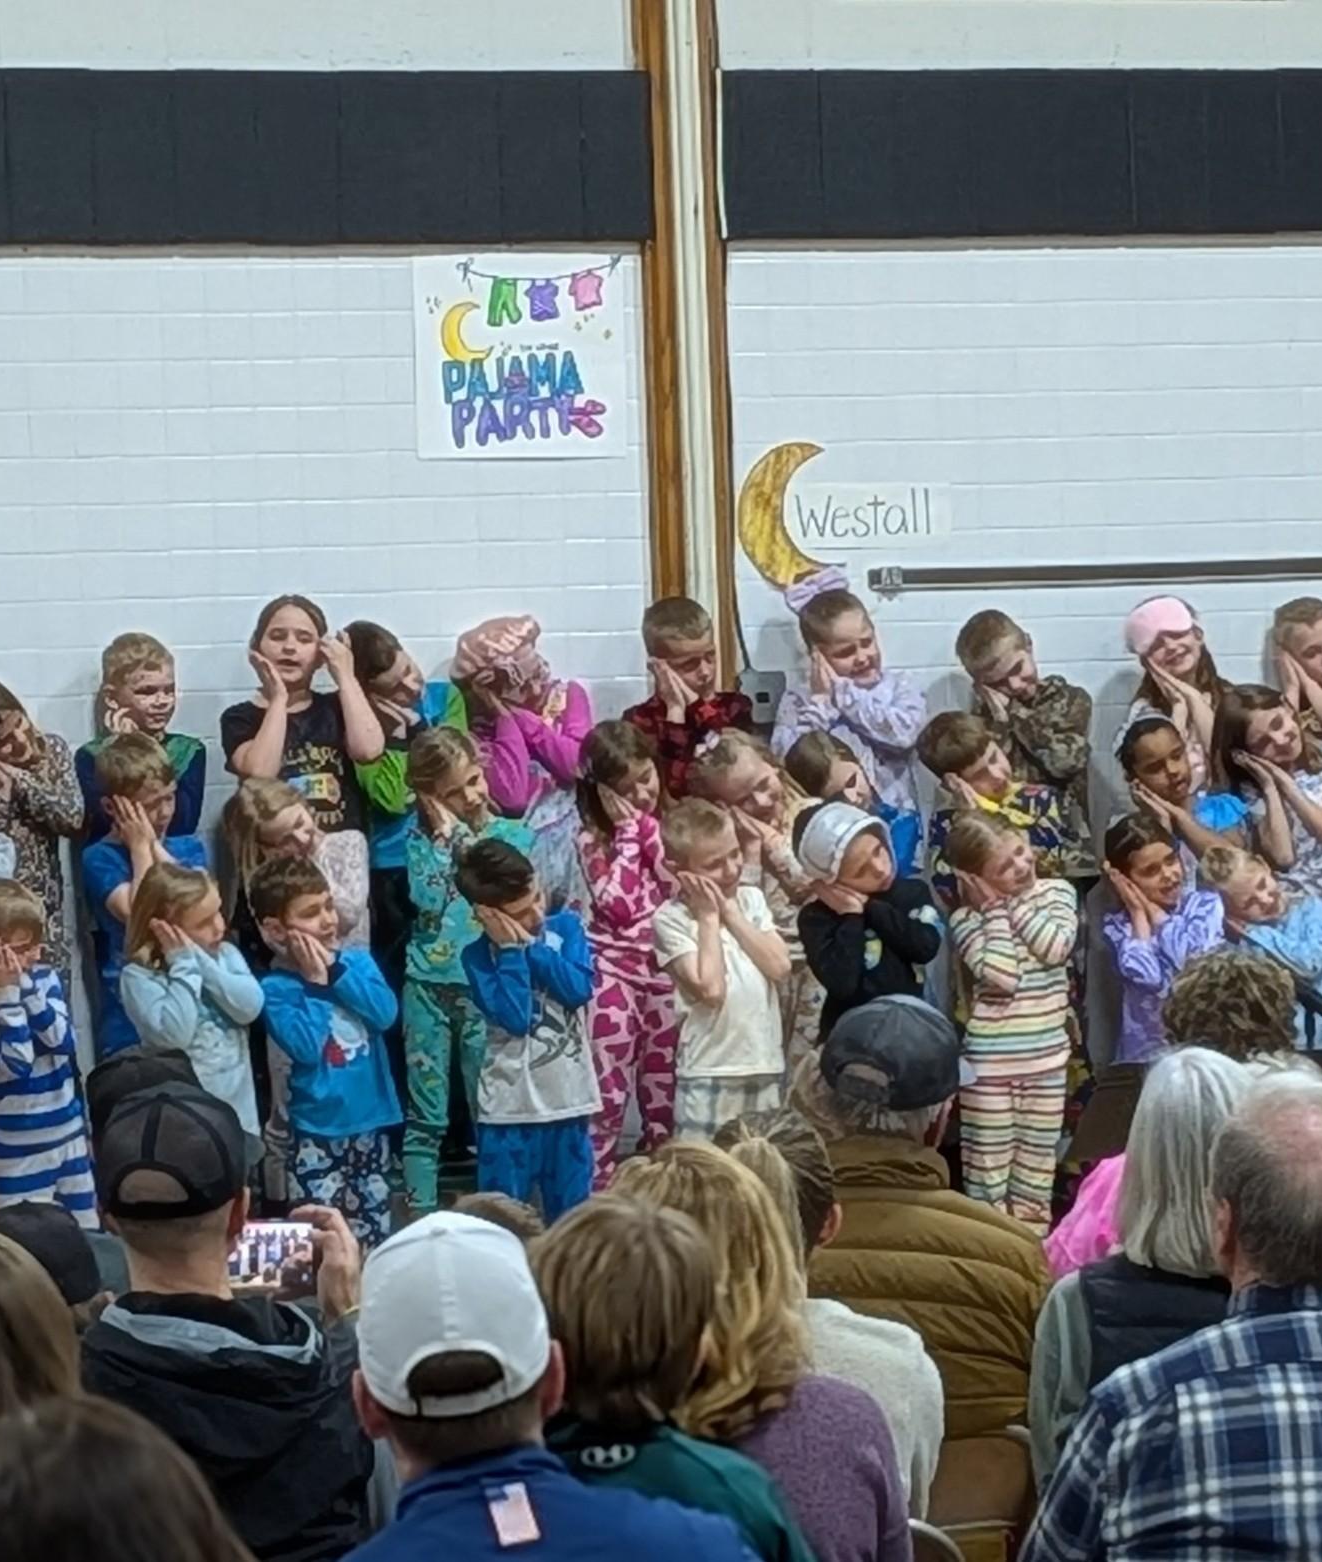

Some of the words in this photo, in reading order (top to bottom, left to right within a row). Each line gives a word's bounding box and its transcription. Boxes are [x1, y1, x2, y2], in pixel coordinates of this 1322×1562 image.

[442, 350, 584, 404] PAJAMA
[451, 393, 574, 449] PARTY
[795, 487, 930, 538] Westall
